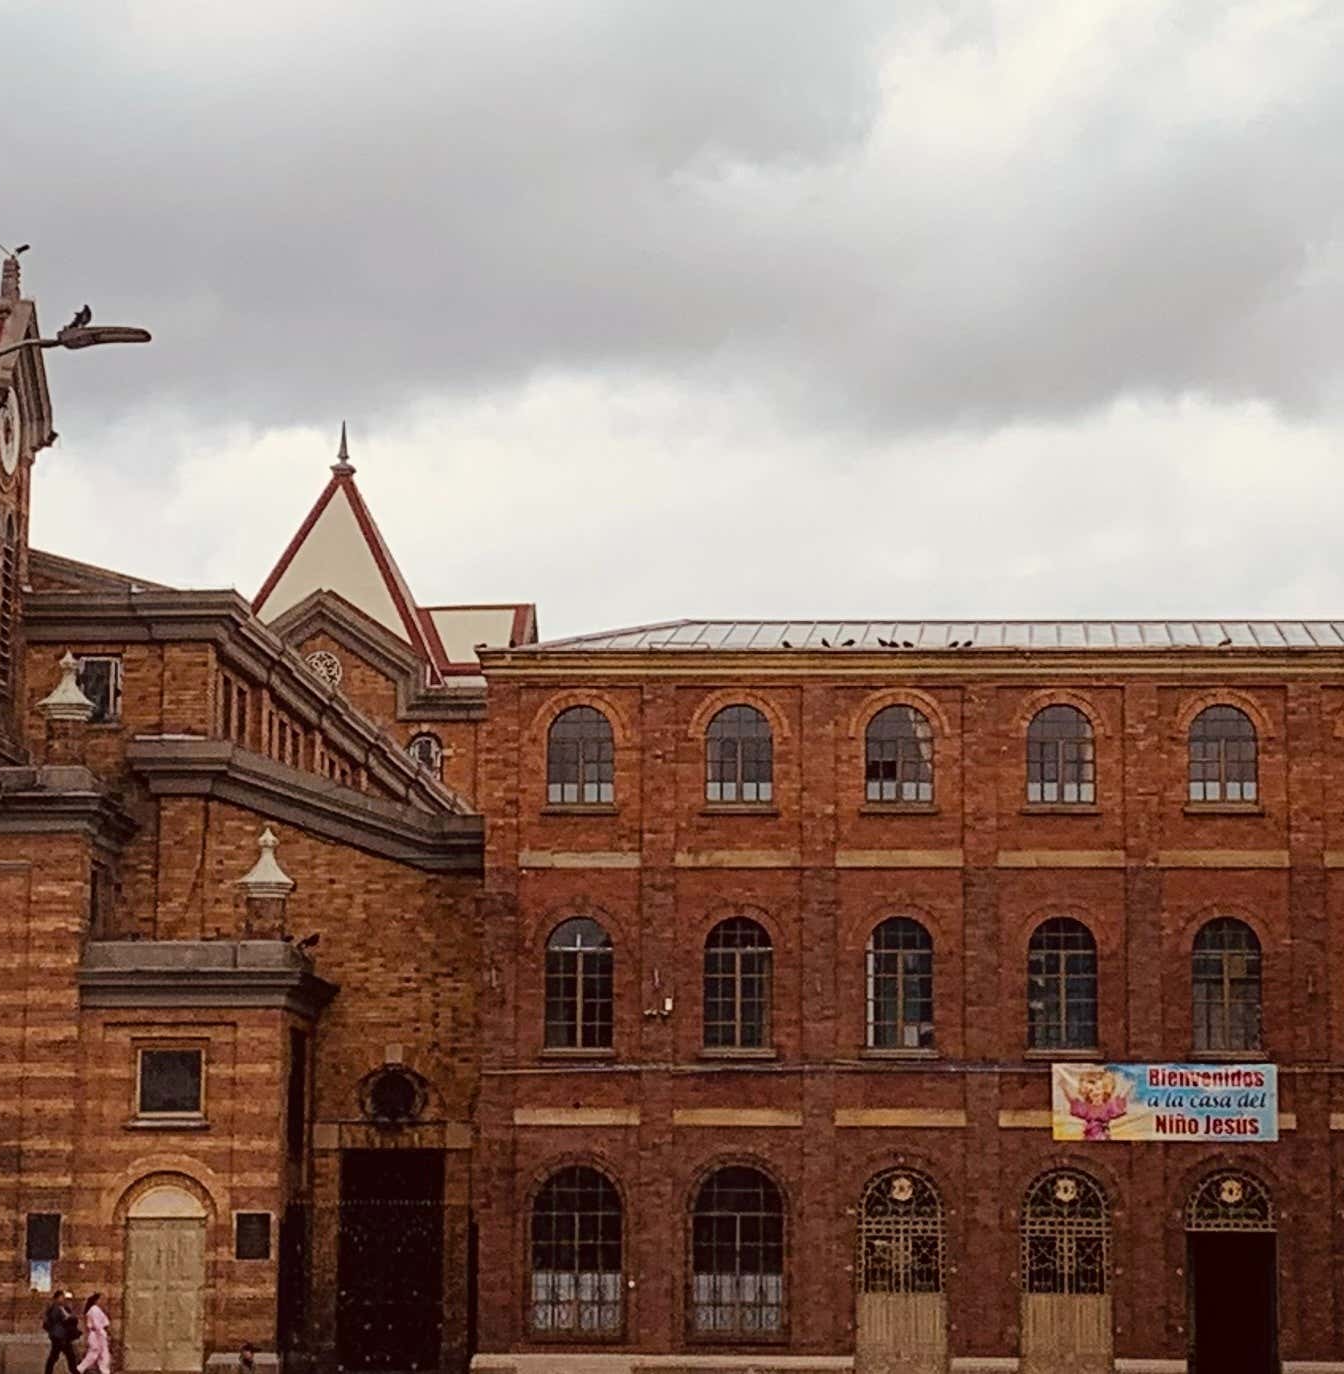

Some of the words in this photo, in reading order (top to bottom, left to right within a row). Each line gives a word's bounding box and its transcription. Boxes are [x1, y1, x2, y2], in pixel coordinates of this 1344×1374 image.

[1149, 1068, 1265, 1088] Bienvenidos
[1147, 1096, 1159, 1108] a
[1164, 1092, 1184, 1108] la
[1189, 1095, 1232, 1109] casa
[1237, 1092, 1267, 1109] del
[1155, 1112, 1199, 1135] Niño
[1203, 1110, 1260, 1135] Jesús
